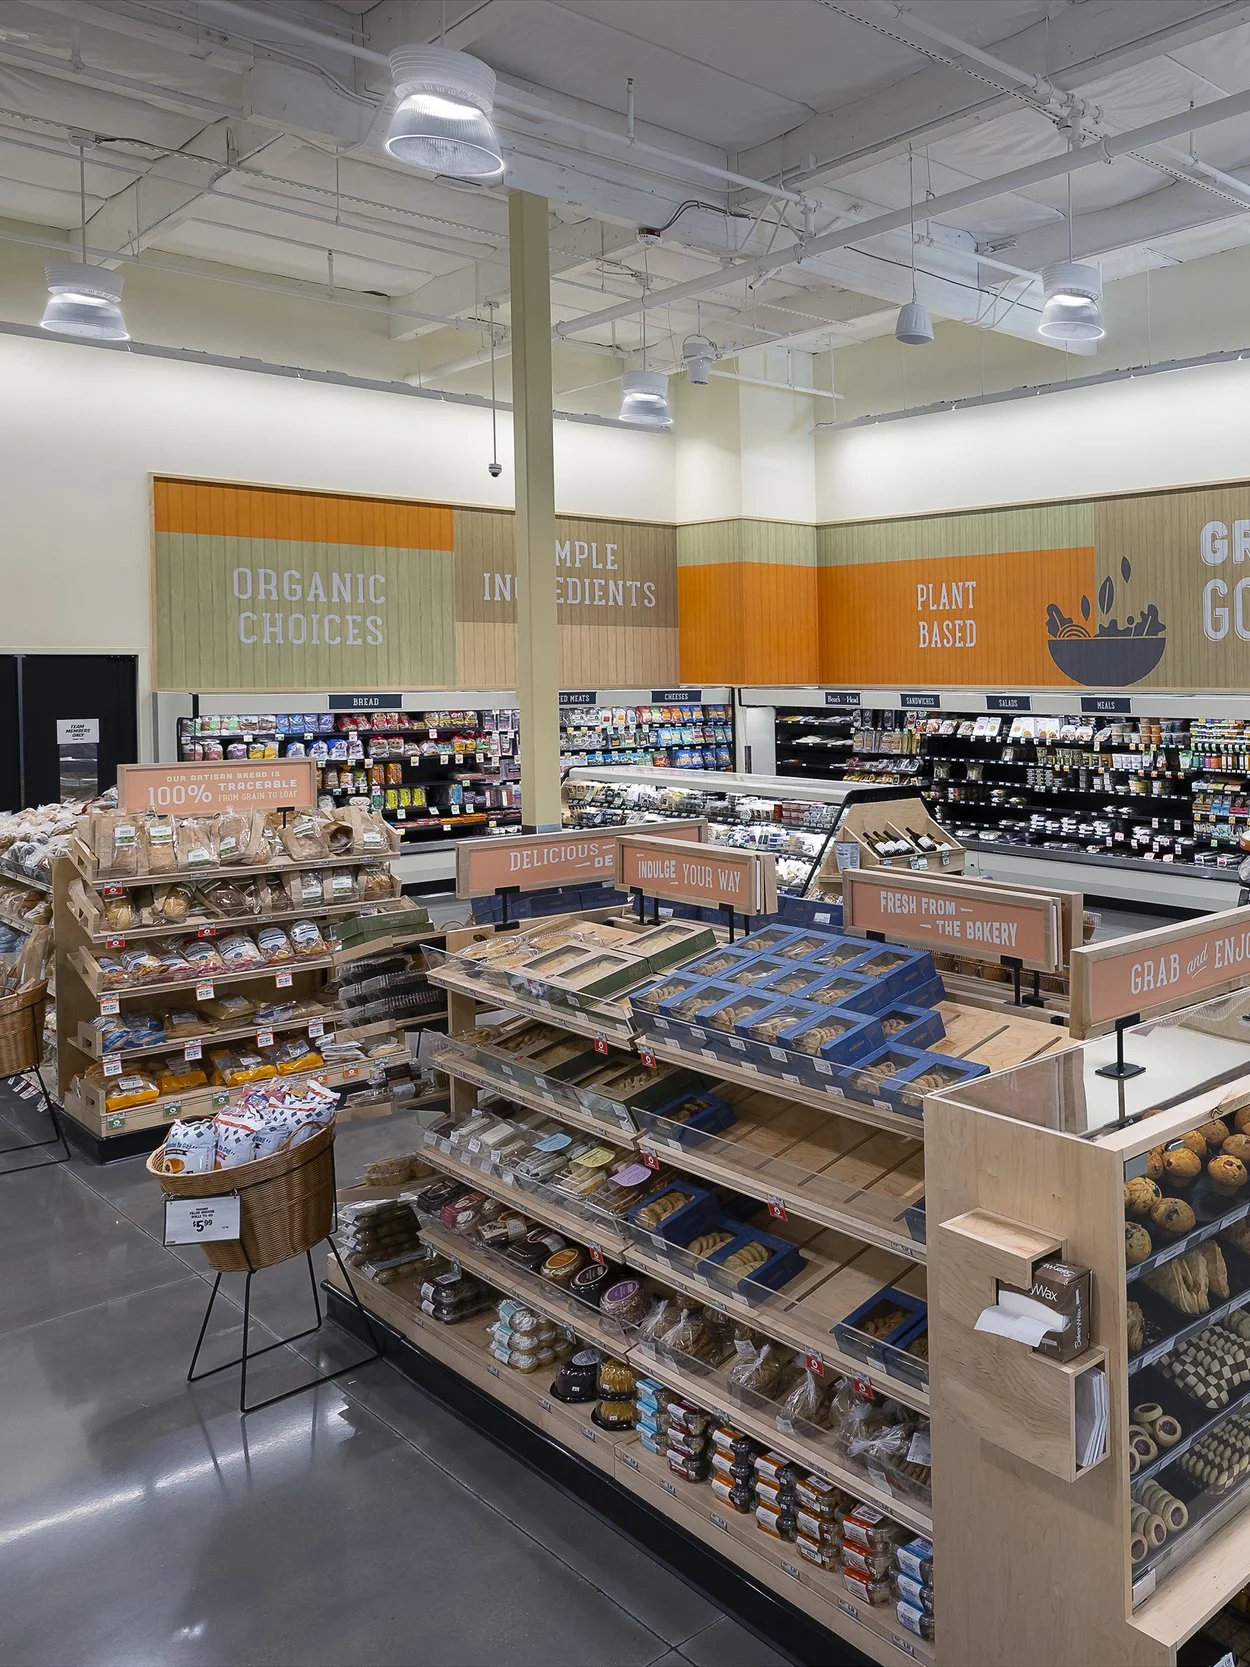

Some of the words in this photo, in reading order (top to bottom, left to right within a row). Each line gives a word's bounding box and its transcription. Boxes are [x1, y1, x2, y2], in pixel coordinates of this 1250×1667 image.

[555, 539, 618, 570] MPLE
[233, 567, 387, 604] ORGANIC
[916, 580, 977, 611] PLANT
[239, 611, 384, 646] CHOICES
[918, 617, 977, 649] BASED
[353, 697, 379, 706] BREAD
[569, 694, 590, 702] MEATS
[664, 692, 689, 701] CHEESES
[906, 697, 935, 706] SANDWICHES
[999, 699, 1018, 708] SALADS
[1097, 700, 1116, 711] MEALS
[190, 773, 233, 781] ARTISAN
[236, 771, 268, 779] BREAD
[271, 770, 280, 778] IS
[218, 779, 297, 791] TRACEABLE
[148, 784, 213, 806] 100%
[218, 793, 239, 802] FROM
[241, 792, 265, 801] GRAIN
[267, 791, 278, 799] TO
[279, 790, 298, 798] LOAF
[509, 843, 599, 872] DELICIOUS
[637, 859, 676, 880] INDULGE
[682, 862, 713, 889] YOUR
[718, 867, 742, 893] WAY
[880, 891, 917, 915] FRESH
[921, 897, 956, 916] FROM
[935, 920, 961, 938] THE
[966, 920, 1018, 947] BAKERY
[1130, 953, 1180, 995] GRAB
[1186, 942, 1209, 975] and
